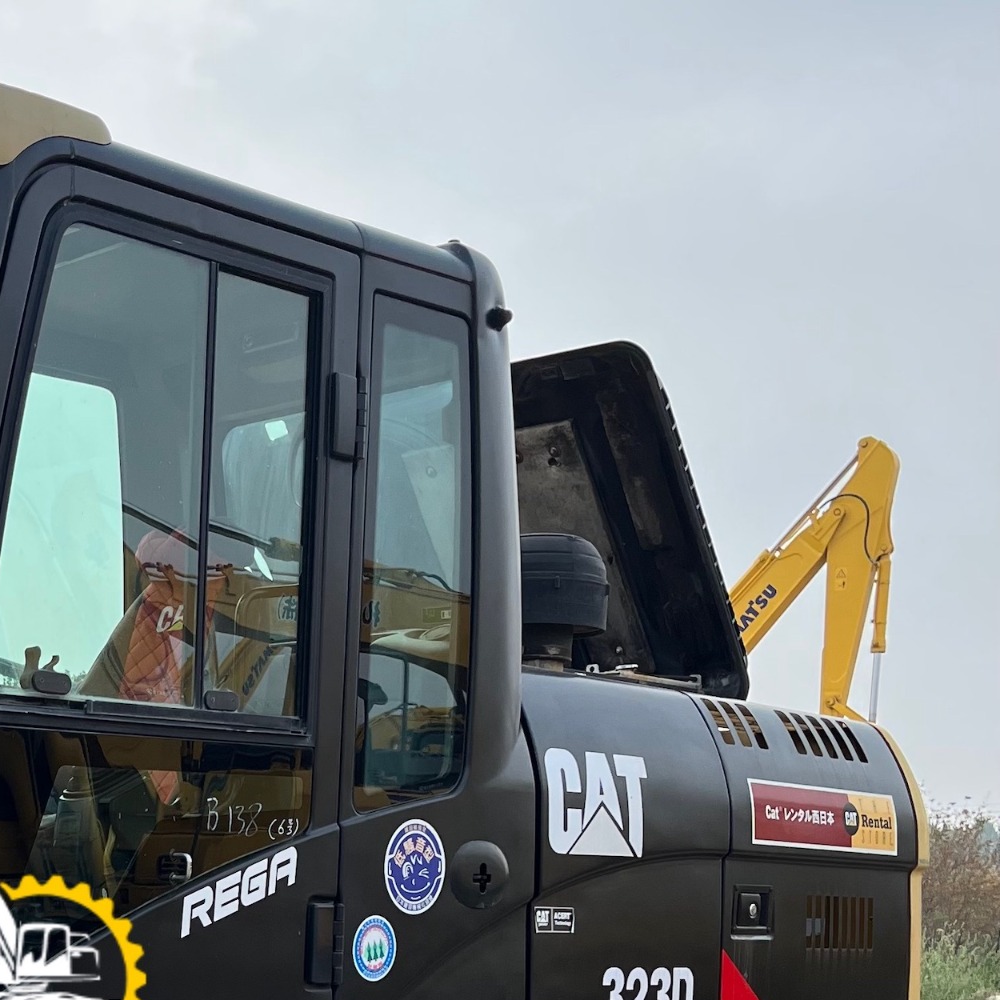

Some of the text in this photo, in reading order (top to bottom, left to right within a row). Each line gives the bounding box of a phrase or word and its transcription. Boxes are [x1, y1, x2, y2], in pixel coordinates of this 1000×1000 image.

[544, 747, 648, 858] CAT
[206, 797, 219, 831] B
[228, 802, 262, 837] 138
[783, 807, 835, 826] レンタル西日本
[844, 811, 858, 827] CAT
[861, 814, 893, 830] Rental
[180, 845, 298, 939] REGA
[536, 910, 550, 923] CAT
